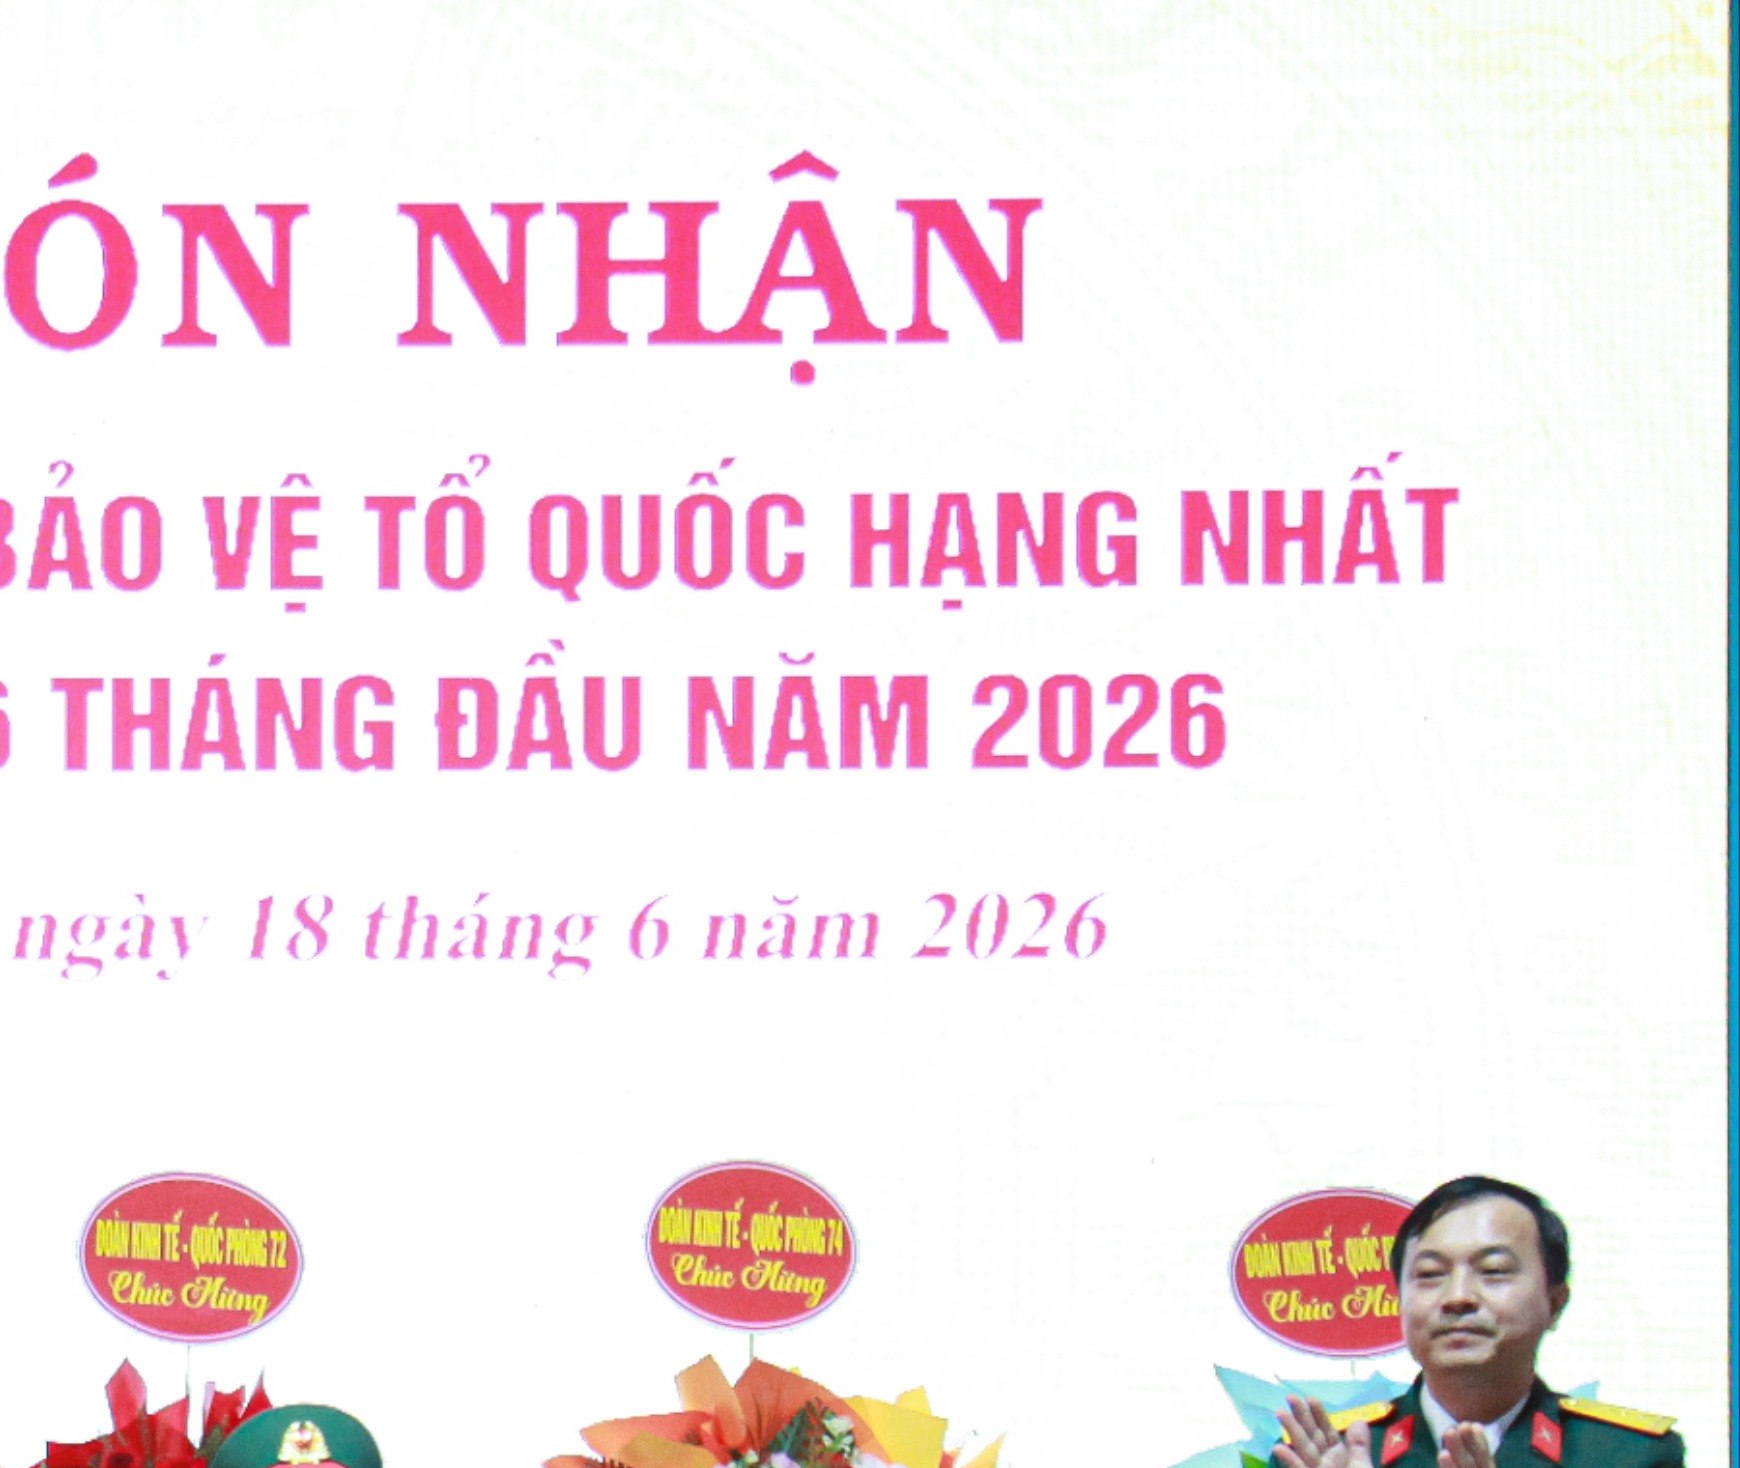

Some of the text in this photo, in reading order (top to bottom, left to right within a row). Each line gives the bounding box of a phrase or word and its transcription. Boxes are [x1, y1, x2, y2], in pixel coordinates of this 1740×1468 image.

[397, 150, 1043, 385] NHẬN
[203, 474, 323, 612] VỆ
[364, 454, 491, 591] TỔ
[529, 458, 804, 602] QUỐC
[851, 491, 1137, 610] HẠNG
[1181, 452, 1459, 585] NHẤT
[51, 654, 394, 772] THÁNG
[435, 639, 641, 772] ĐẦU
[688, 652, 928, 769] NĂM
[972, 674, 1226, 770] 2026
[13, 894, 210, 980] ngày
[251, 894, 334, 960] 18
[365, 893, 600, 980] tháng
[628, 895, 670, 960] 6
[702, 896, 878, 959] năm
[912, 893, 1107, 959] 2026
[270, 1230, 287, 1268] 72
[827, 1219, 844, 1256] 74
